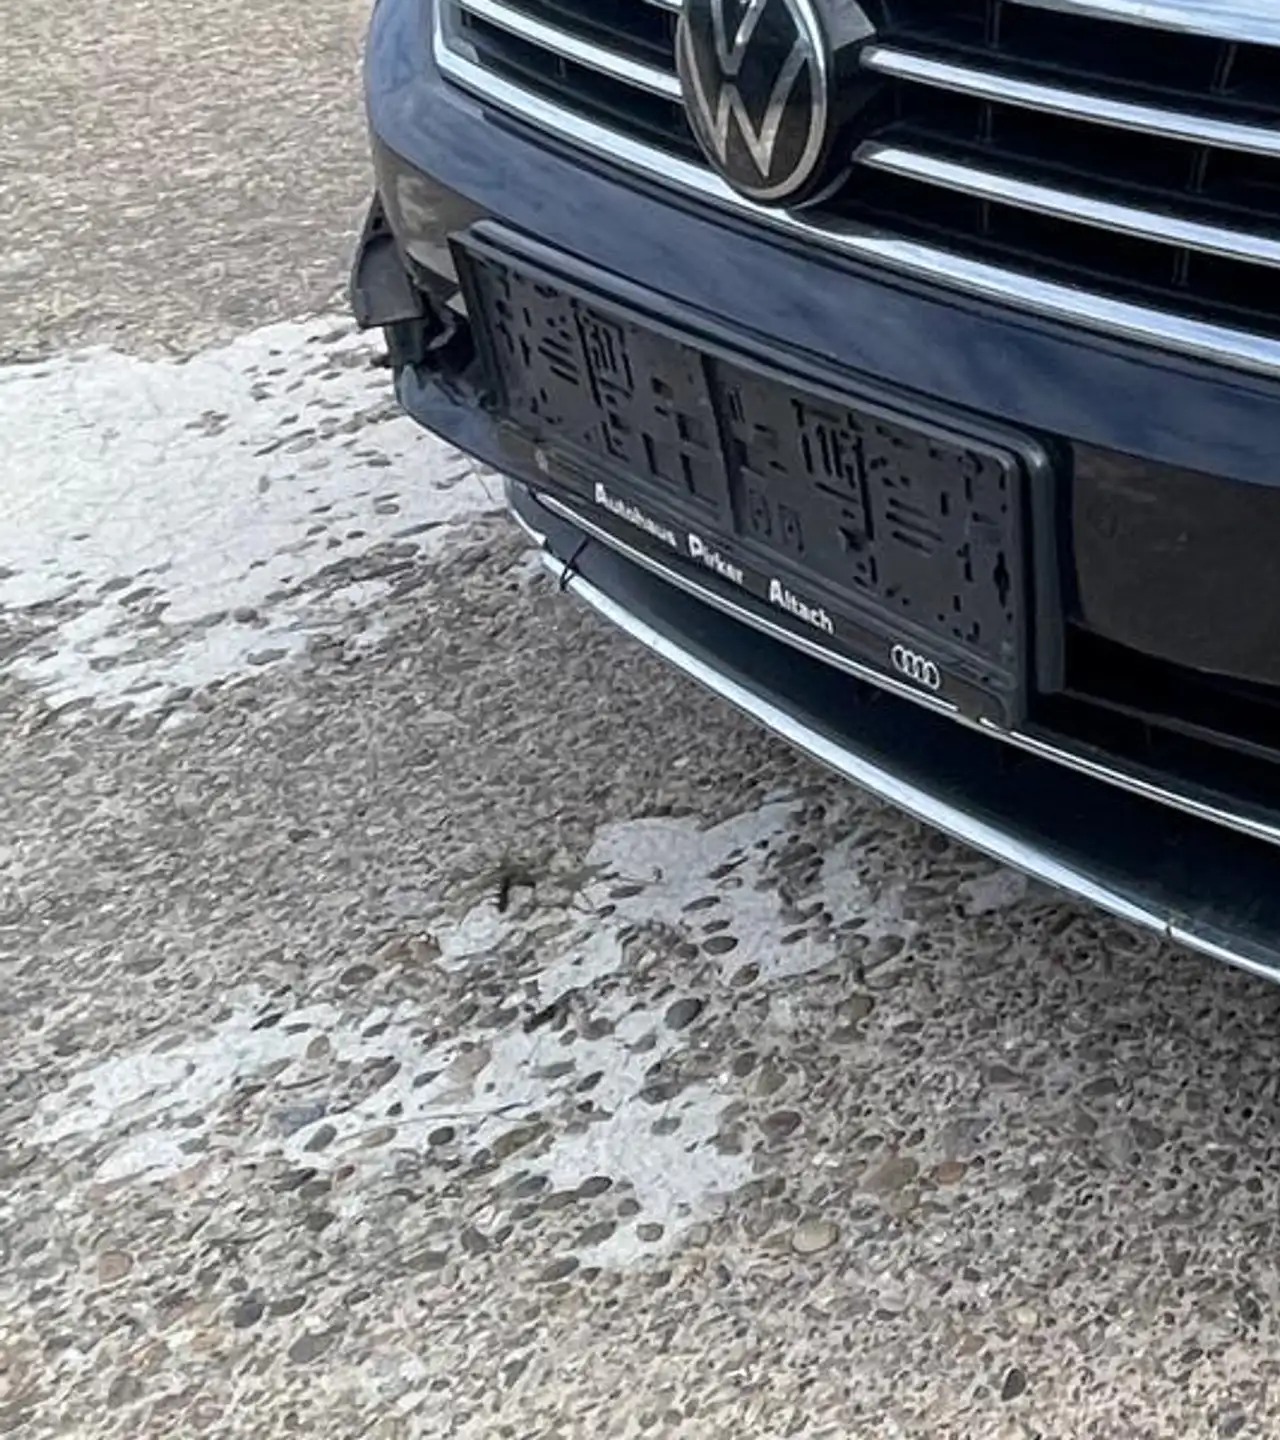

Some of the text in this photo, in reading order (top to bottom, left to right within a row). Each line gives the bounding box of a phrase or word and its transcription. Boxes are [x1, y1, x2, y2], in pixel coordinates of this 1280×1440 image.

[595, 482, 835, 636] Autohaus Pirker Altach
